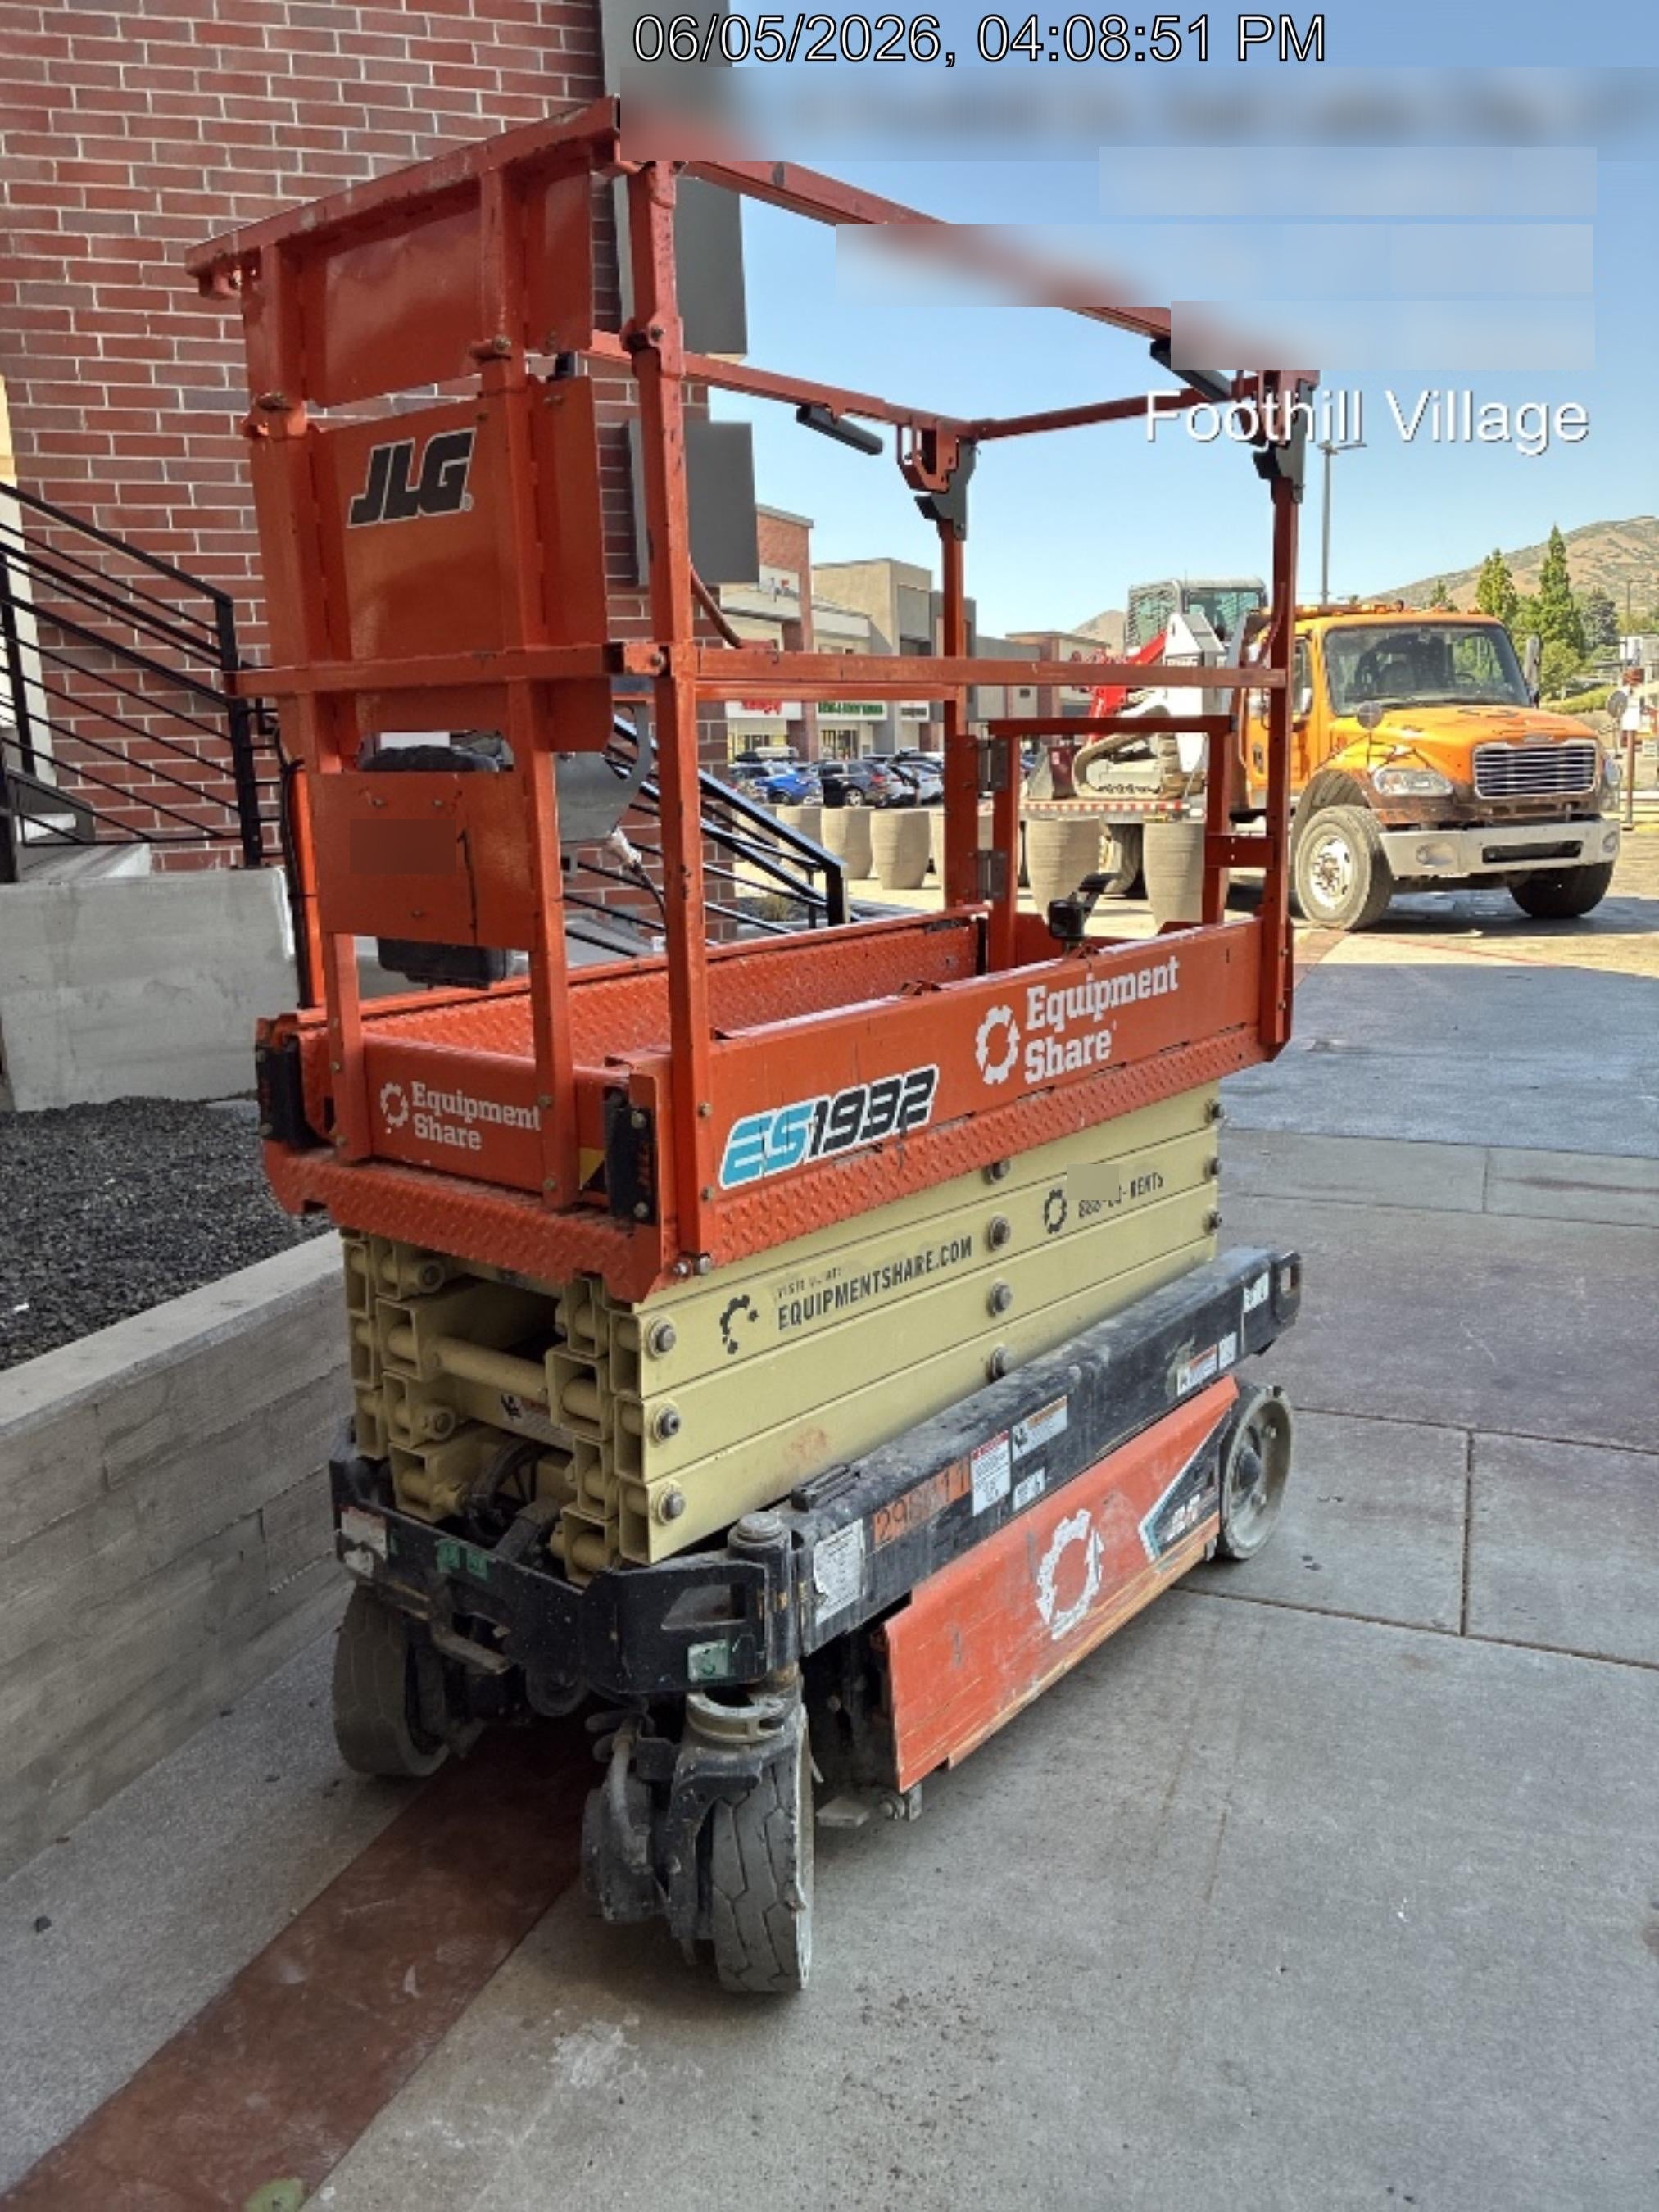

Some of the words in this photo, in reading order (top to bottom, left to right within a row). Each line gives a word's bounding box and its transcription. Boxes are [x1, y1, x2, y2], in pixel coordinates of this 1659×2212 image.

[347, 427, 477, 528] JLG
[1026, 955, 1179, 1033] Equipment
[1024, 1029, 1113, 1084] Share
[411, 1081, 542, 1131] Equipment
[413, 1113, 483, 1150] Share
[719, 1063, 940, 1190] ES1932
[778, 1235, 972, 1331] EQUIPMENTSHARE.COM
